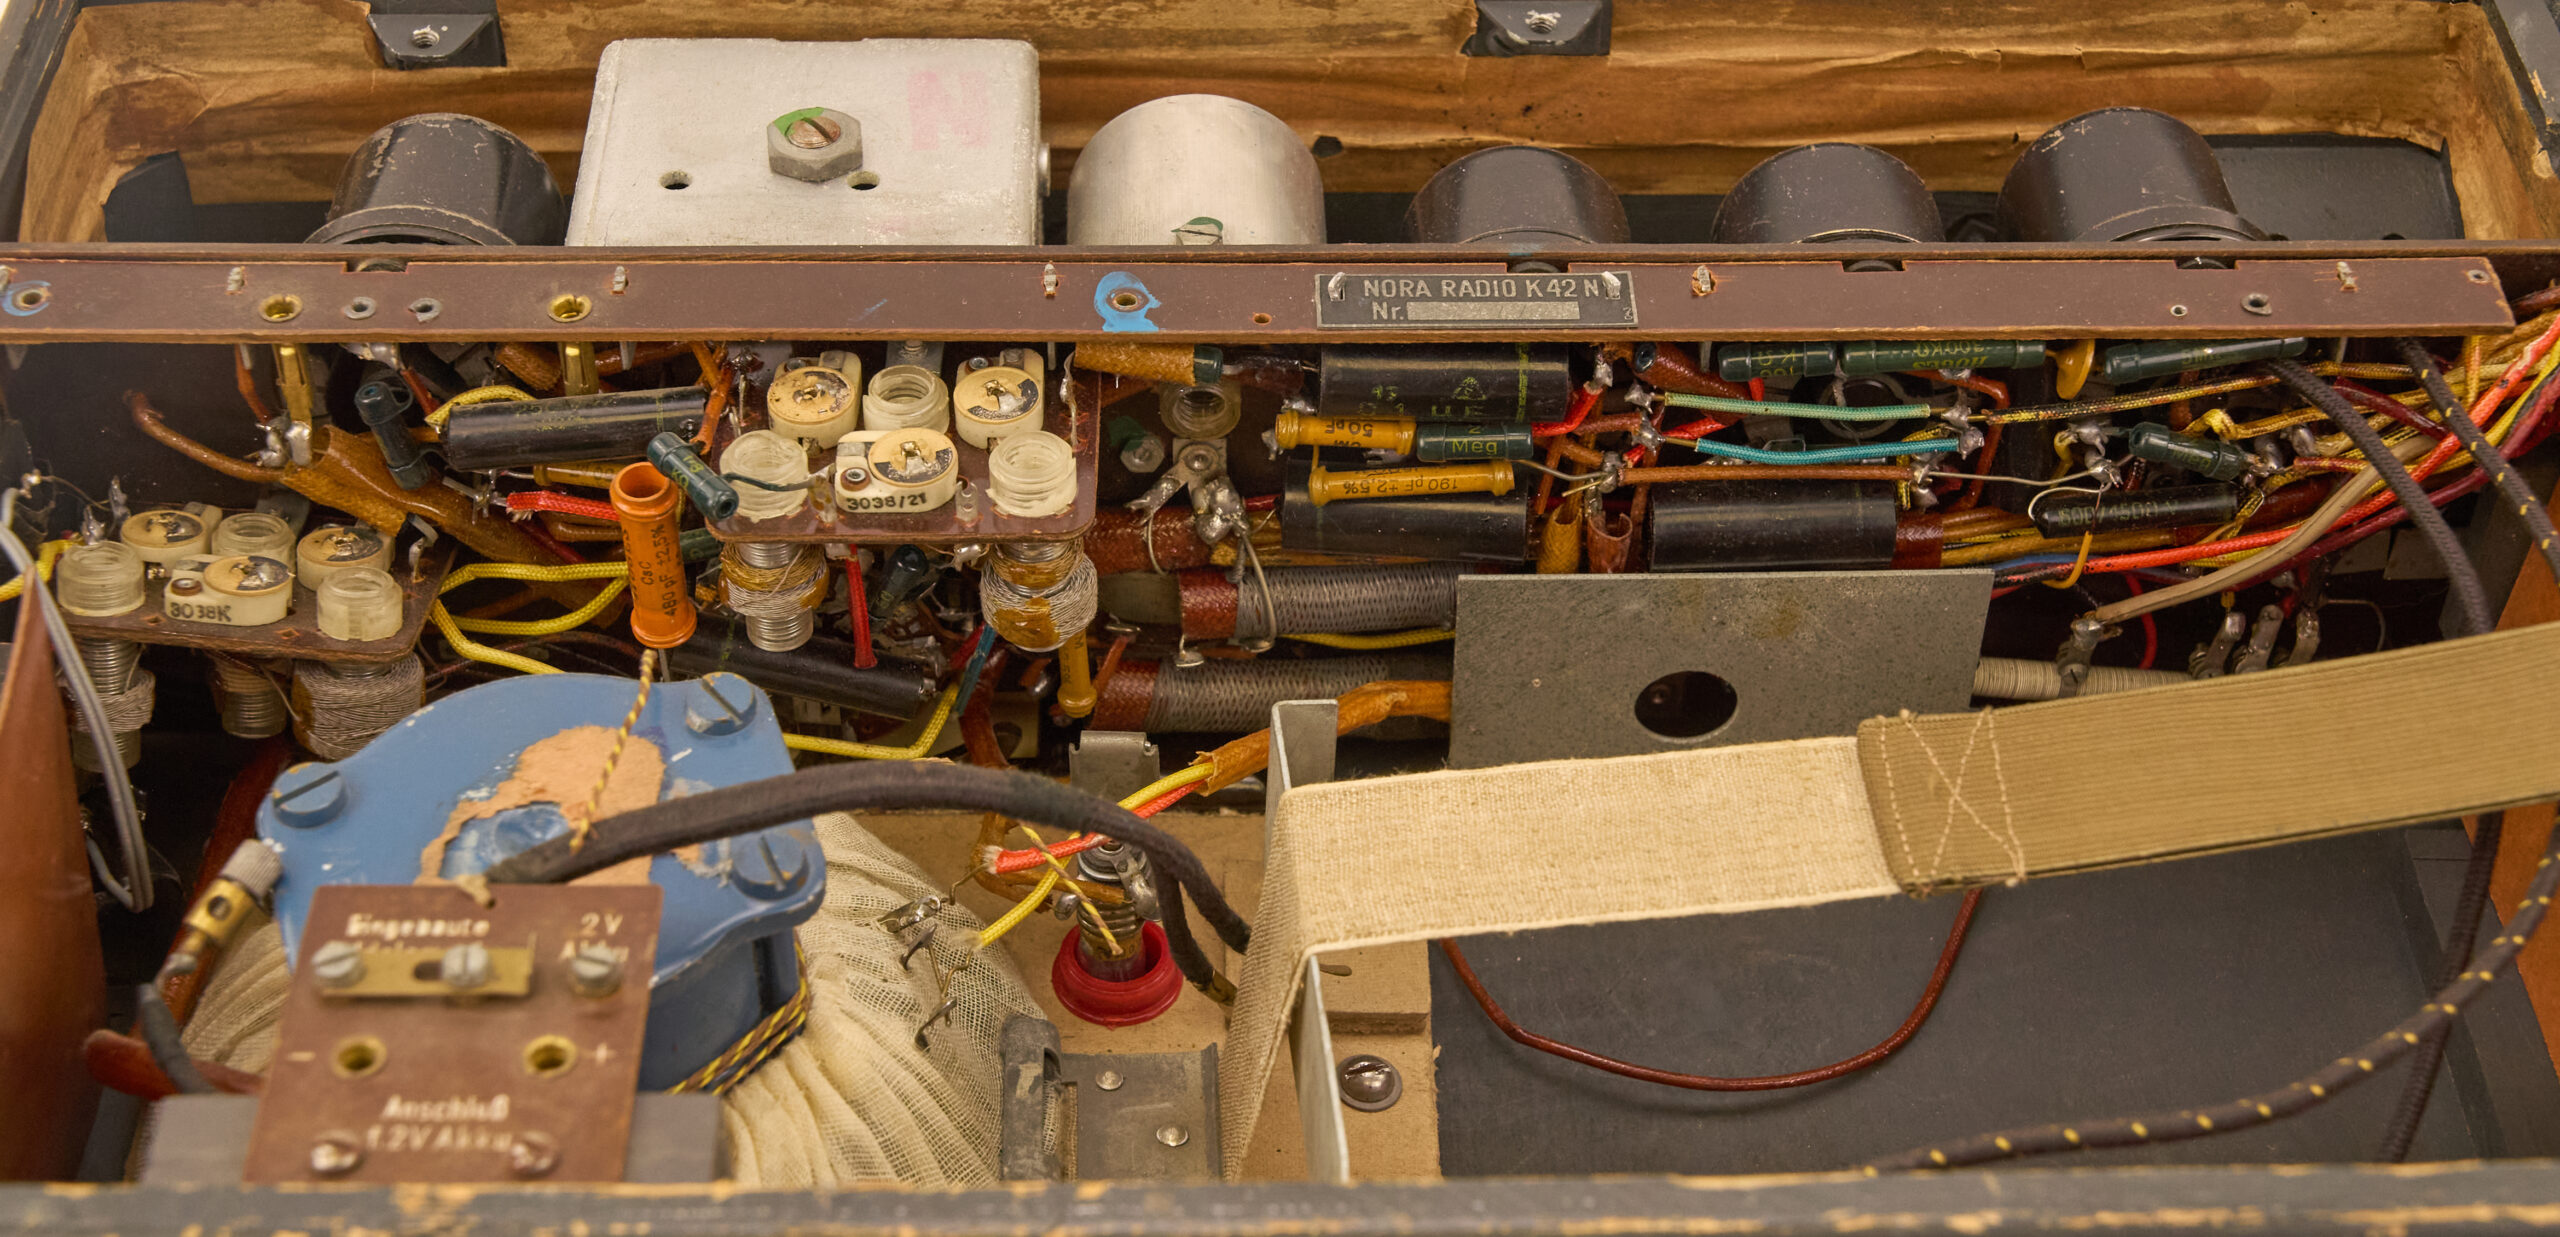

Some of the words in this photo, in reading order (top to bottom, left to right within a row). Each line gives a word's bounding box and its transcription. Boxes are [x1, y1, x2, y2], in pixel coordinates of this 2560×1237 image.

[1363, 279, 1432, 298] NORA
[1441, 279, 1517, 298] RADIO
[1372, 301, 1404, 320] Nr.
[1348, 421, 1374, 439] 50
[1452, 439, 1498, 455] Meg
[1405, 474, 1424, 493] pF
[1427, 477, 1459, 492] 190
[846, 492, 927, 511] 3038/21
[169, 601, 233, 623] 3038K
